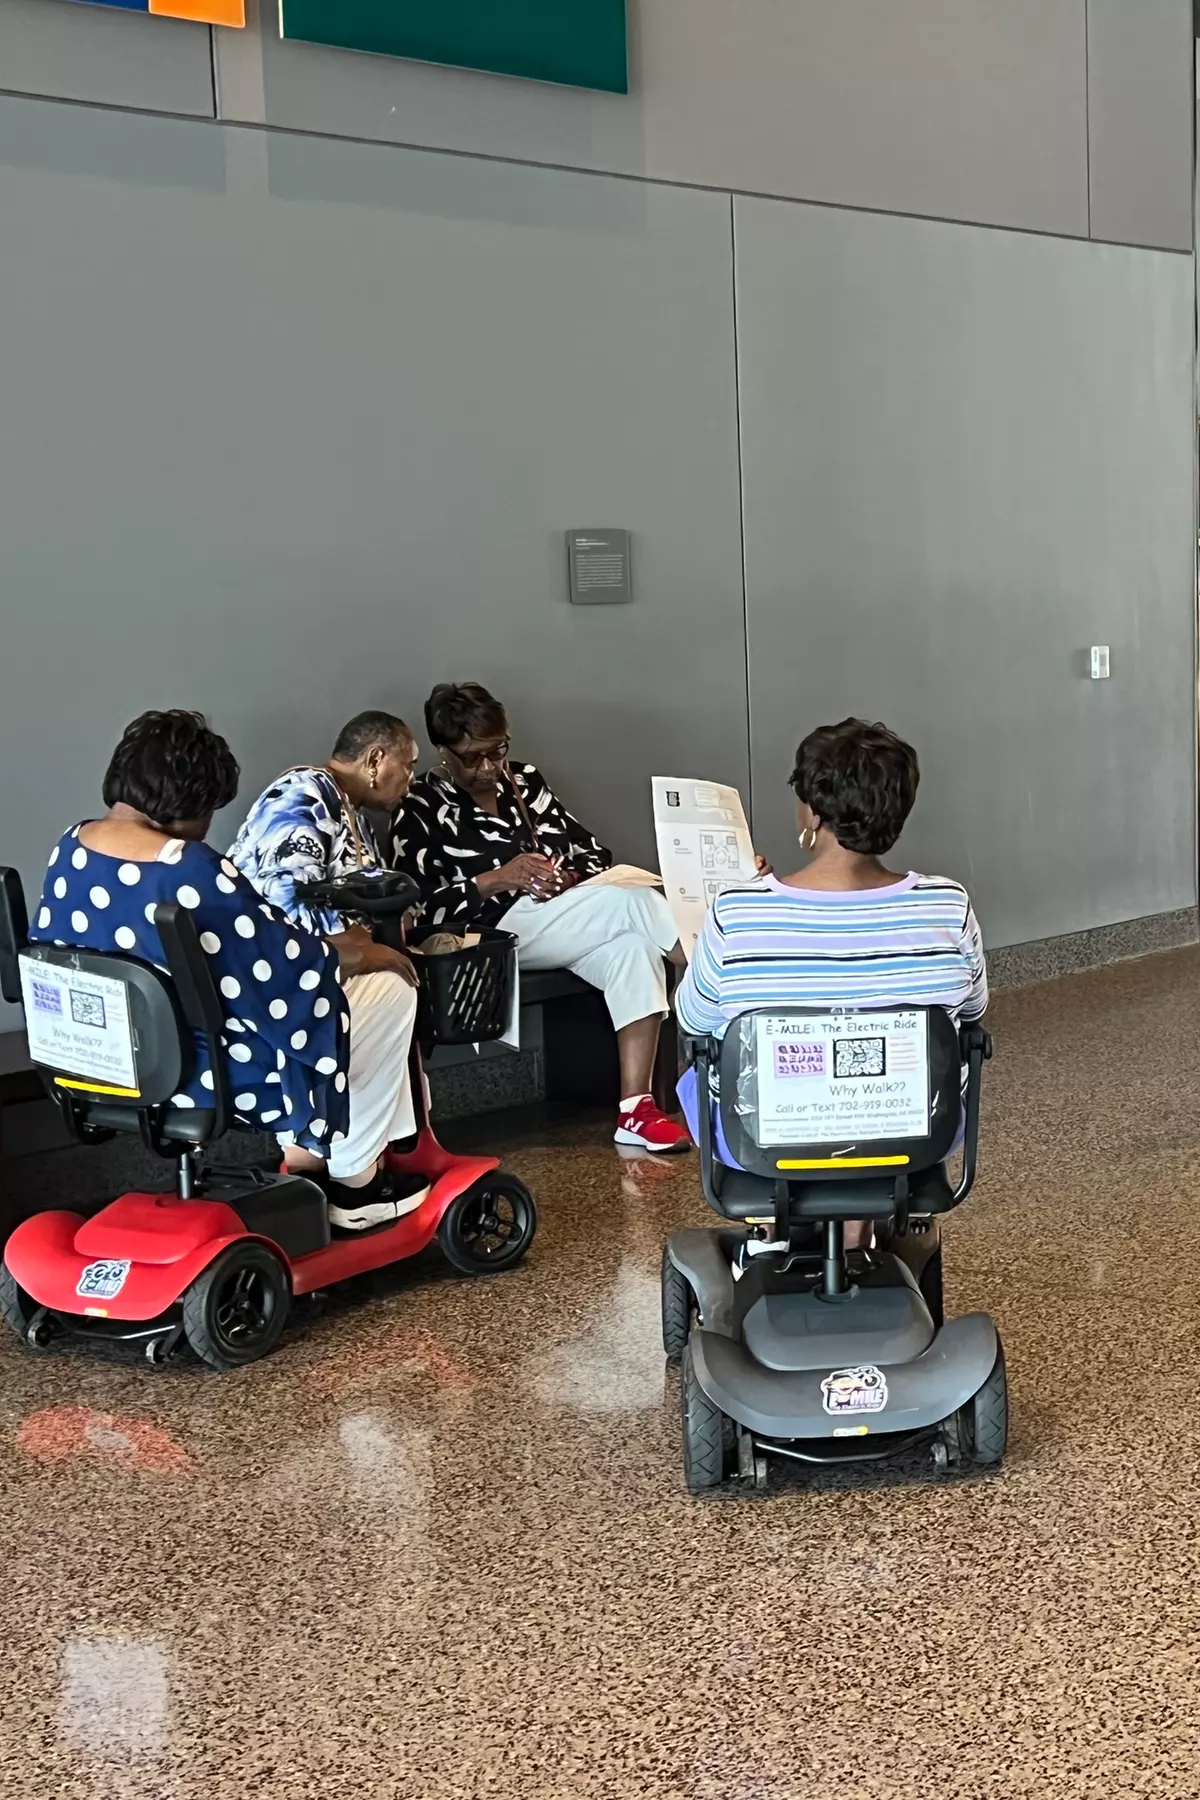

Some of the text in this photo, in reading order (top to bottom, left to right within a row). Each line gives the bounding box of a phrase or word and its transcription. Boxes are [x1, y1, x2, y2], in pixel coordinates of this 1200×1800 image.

[821, 1023, 842, 1033] The
[847, 1021, 890, 1033] Electric
[894, 1019, 917, 1029] Ride
[829, 1081, 906, 1098] Why Walk??
[776, 1103, 794, 1113] Call
[796, 1105, 808, 1113] or
[811, 1102, 836, 1112] Text
